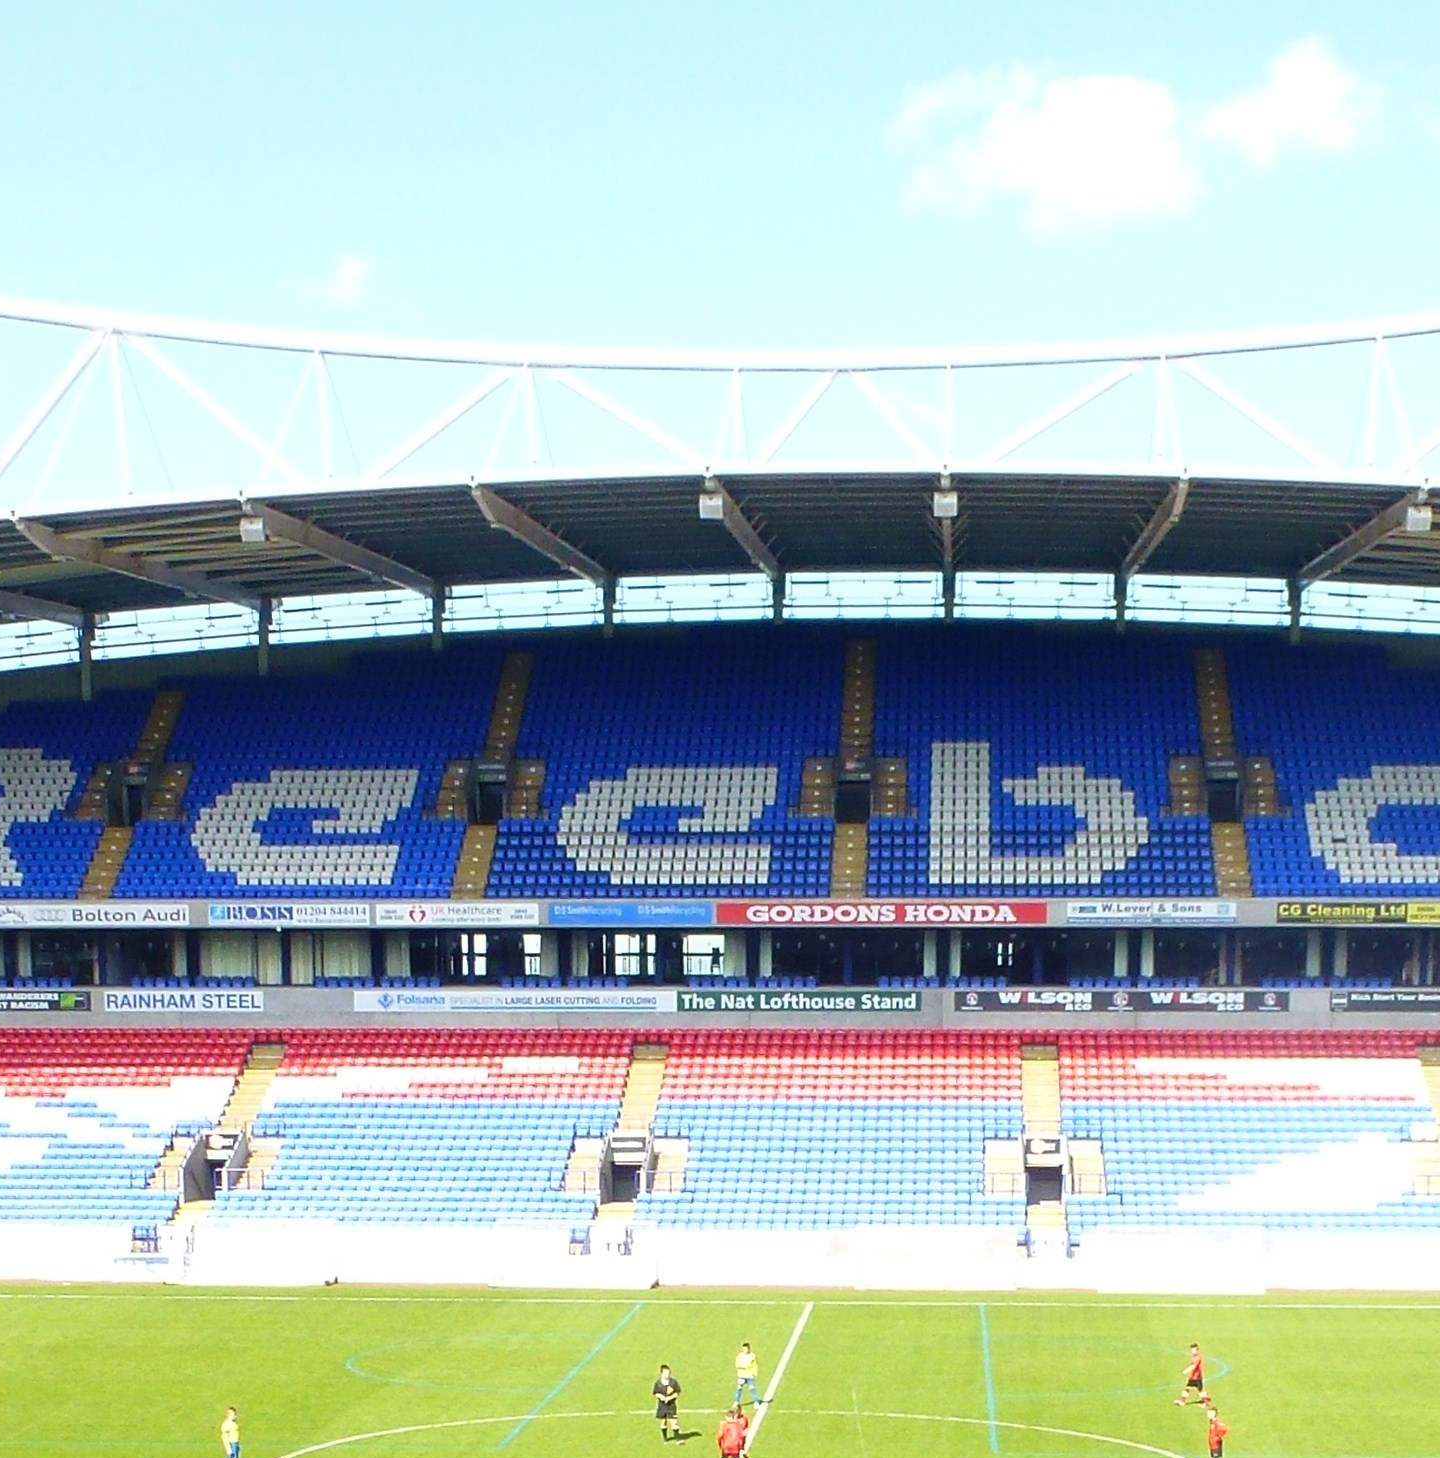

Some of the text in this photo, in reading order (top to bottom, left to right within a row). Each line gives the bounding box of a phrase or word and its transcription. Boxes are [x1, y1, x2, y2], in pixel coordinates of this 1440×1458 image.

[431, 906, 446, 916] UK
[448, 905, 502, 916] Healthcare
[746, 904, 1017, 923] GORDONS HONDA
[1158, 903, 1167, 912] &
[1172, 903, 1202, 912] Sons
[1279, 904, 1302, 916] CG
[1307, 904, 1376, 919] Cleaning
[1380, 904, 1406, 916] Ltd
[72, 908, 186, 922] Bolton Audi
[10, 1001, 49, 1010] RACISM
[106, 994, 262, 1009] RAINHAM STEEL
[396, 994, 445, 1005] Folsana
[504, 996, 534, 1006] LARGE
[535, 996, 562, 1006] LASER
[564, 996, 601, 1006] CUTTING
[620, 996, 657, 1006] FOLDING
[681, 993, 917, 1010] The Nat Lofthouse Stand
